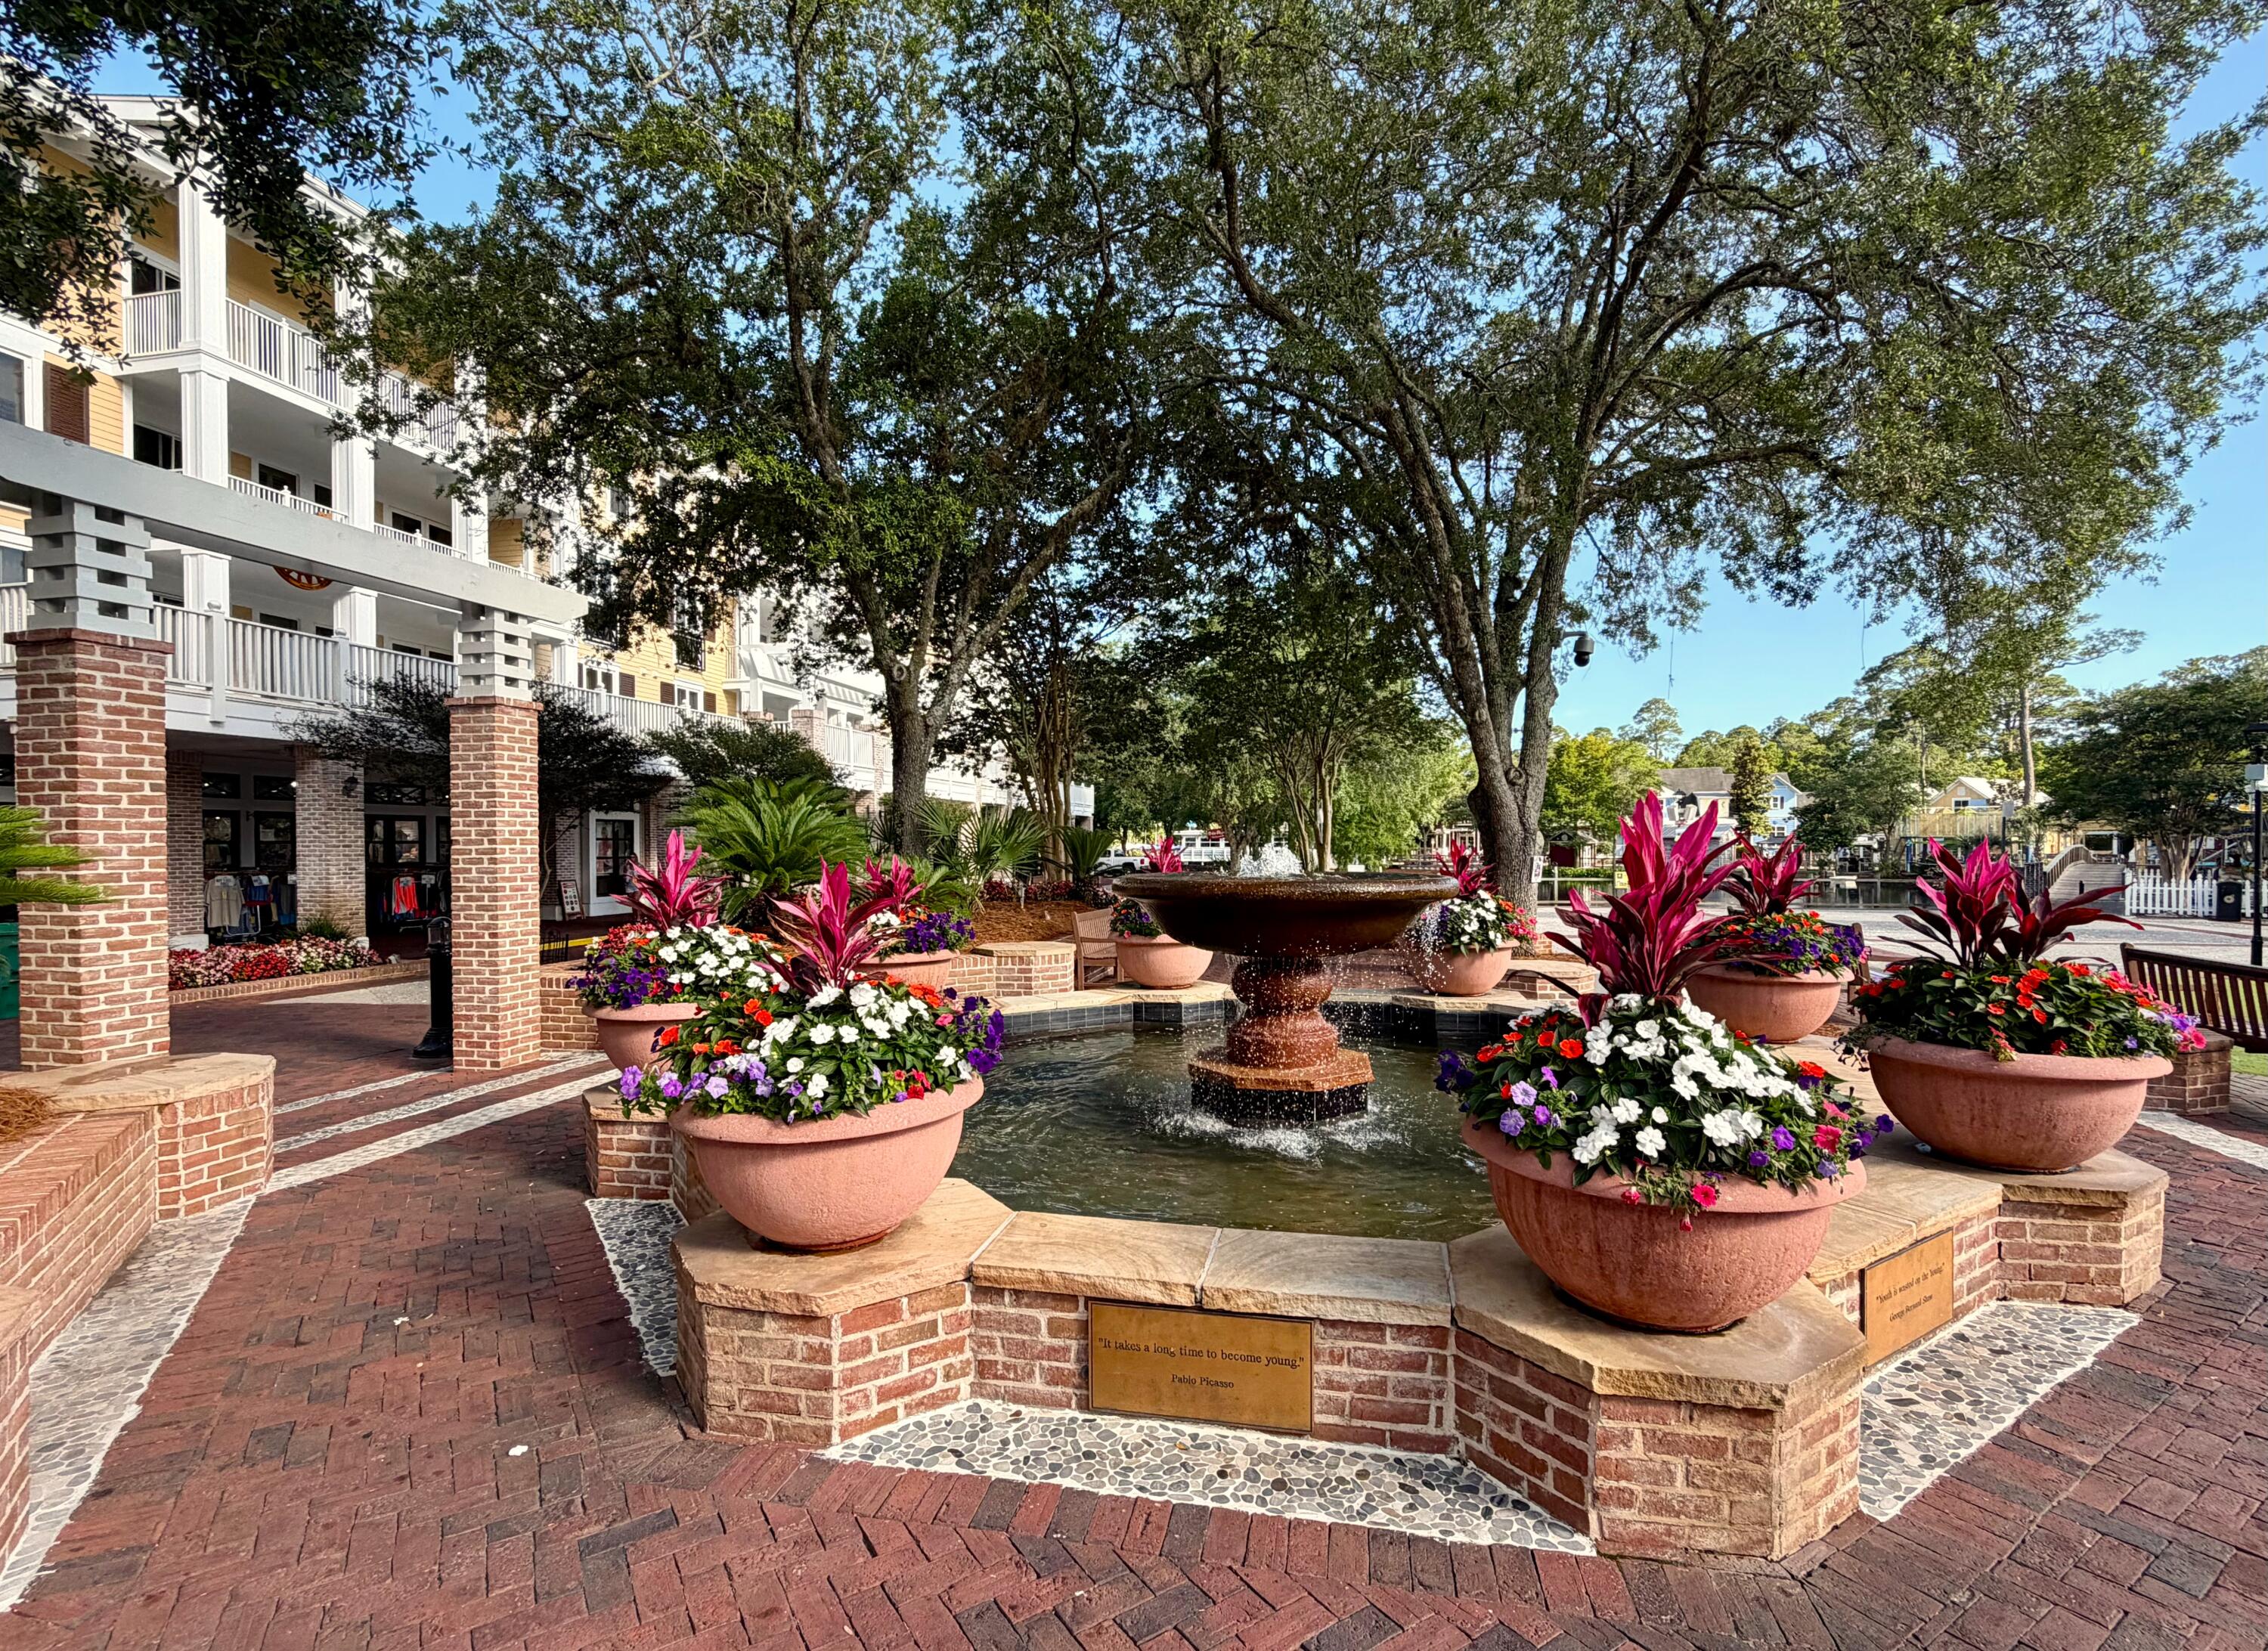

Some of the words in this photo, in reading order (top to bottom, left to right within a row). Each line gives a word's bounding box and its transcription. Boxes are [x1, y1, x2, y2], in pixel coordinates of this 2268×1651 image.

[1098, 1337, 1111, 1349] "It
[1114, 1340, 1141, 1352] takes
[1154, 1343, 1176, 1358] long
[1179, 1346, 1204, 1358] time
[1207, 1349, 1217, 1358] to
[1221, 1349, 1262, 1363] become
[1265, 1355, 1304, 1370] young."
[1171, 1374, 1197, 1385] Pablo
[1200, 1377, 1235, 1388] Picasso
